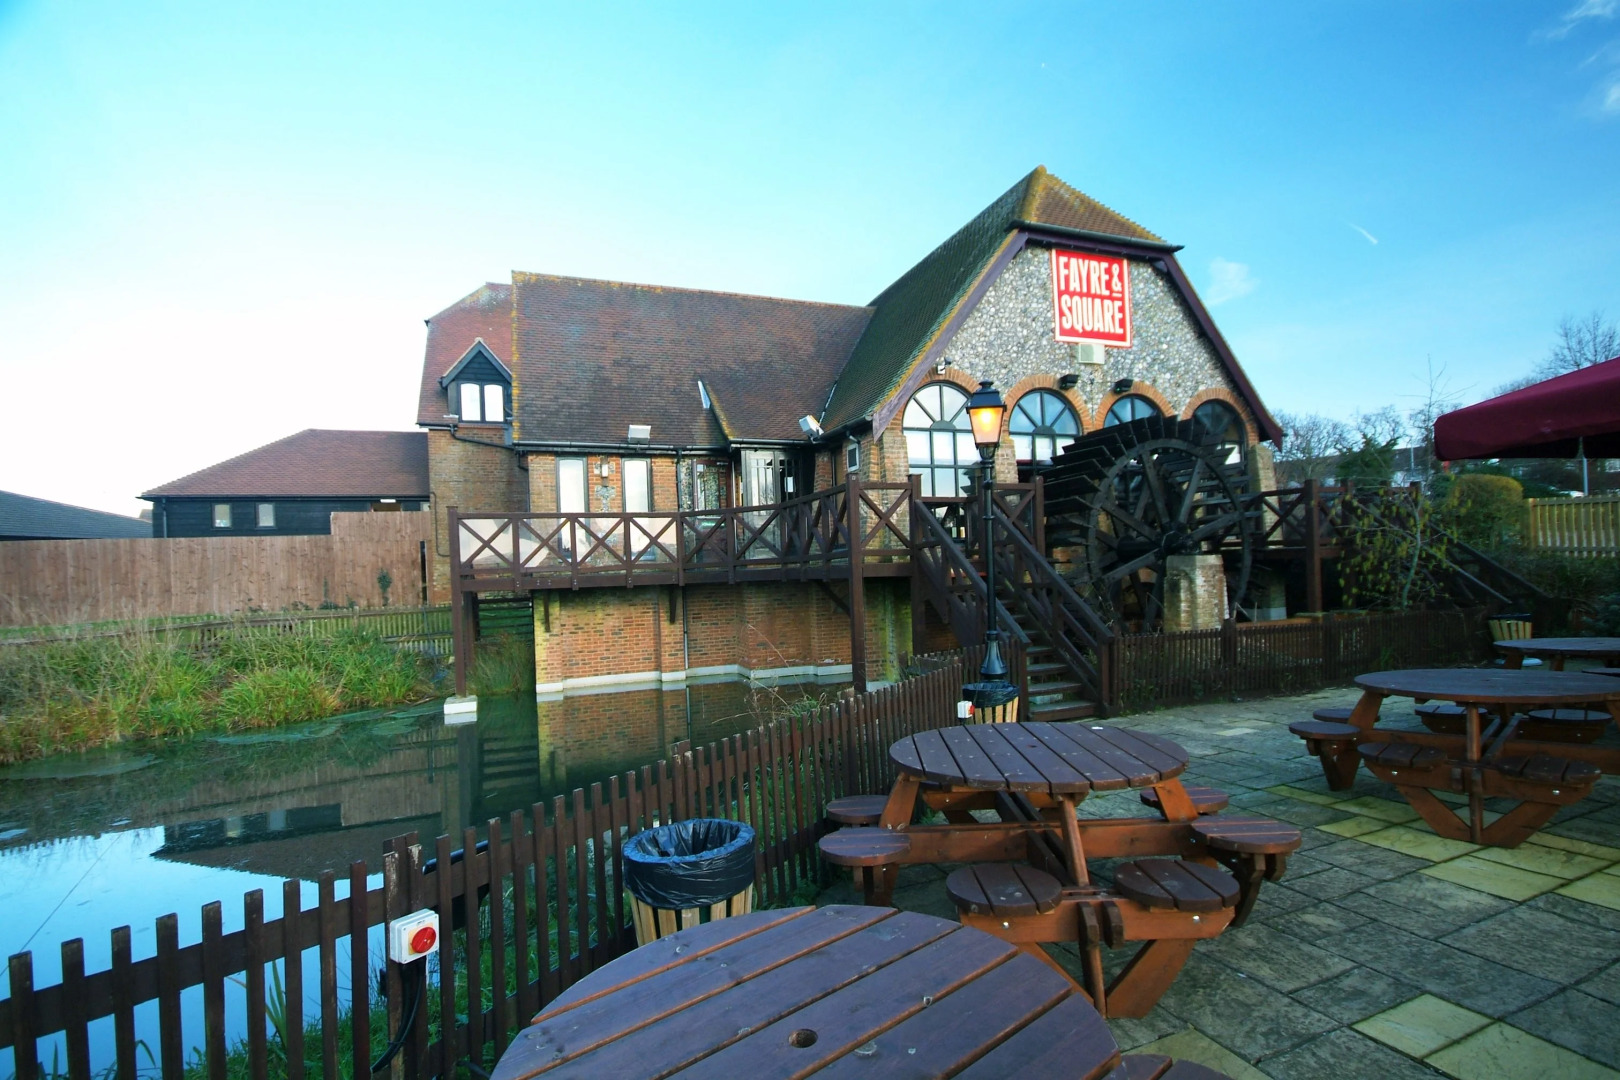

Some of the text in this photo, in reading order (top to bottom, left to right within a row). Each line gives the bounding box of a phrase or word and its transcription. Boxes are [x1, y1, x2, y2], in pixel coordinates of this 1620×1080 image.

[1058, 255, 1122, 297] FAYRE &
[1060, 294, 1124, 334] SQUARE
